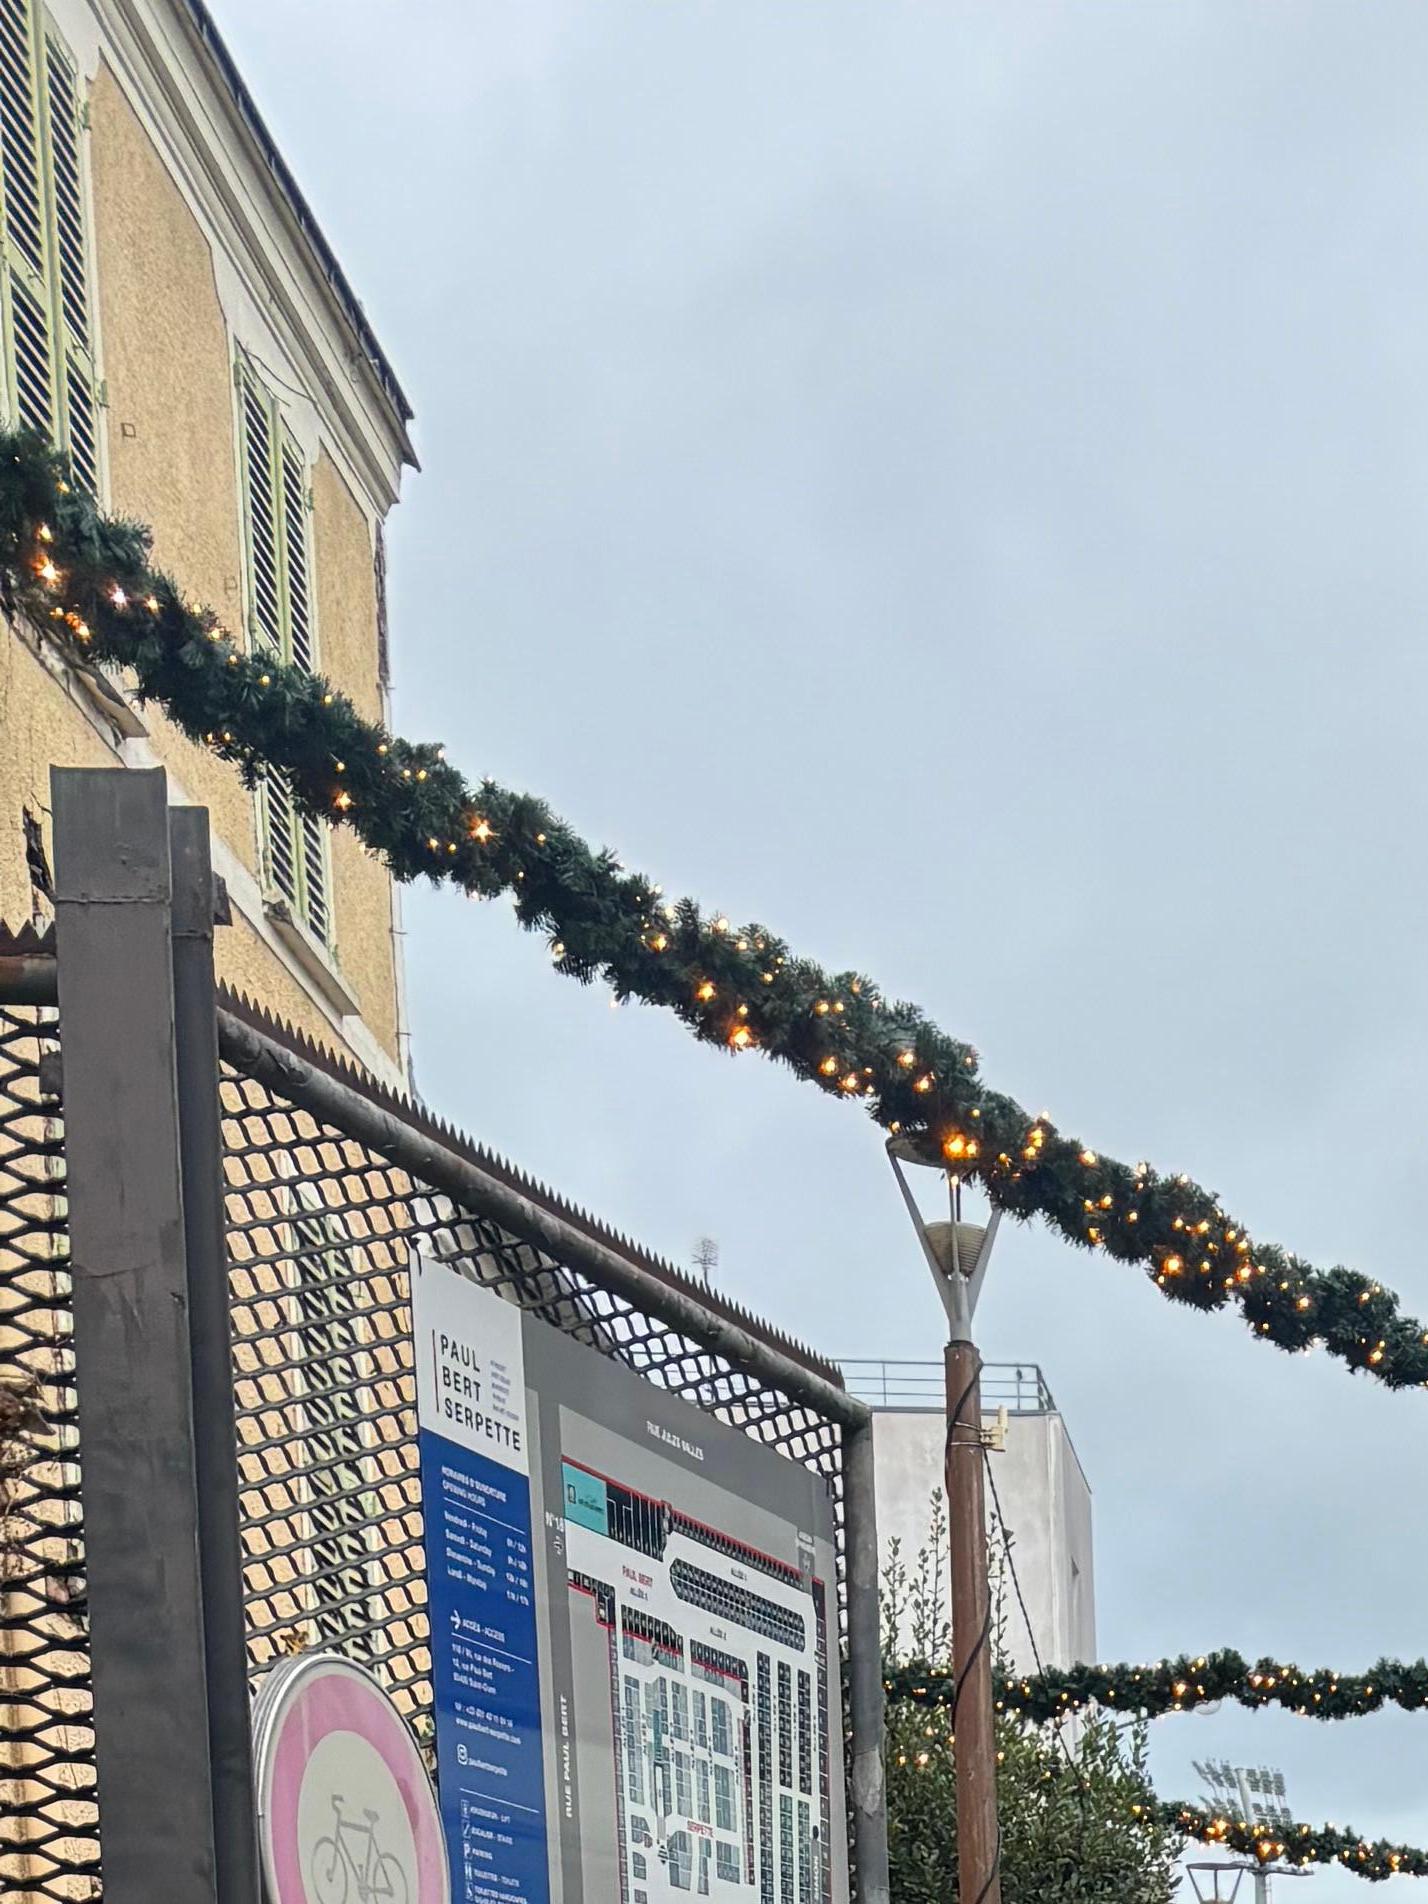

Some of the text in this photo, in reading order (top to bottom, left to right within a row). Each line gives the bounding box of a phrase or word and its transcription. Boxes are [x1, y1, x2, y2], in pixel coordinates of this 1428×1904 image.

[440, 1333, 480, 1373] PAUL
[442, 1365, 481, 1402] BERT
[444, 1397, 521, 1452] SERPETTE
[560, 1695, 574, 1819] RUE PAUL BERT
